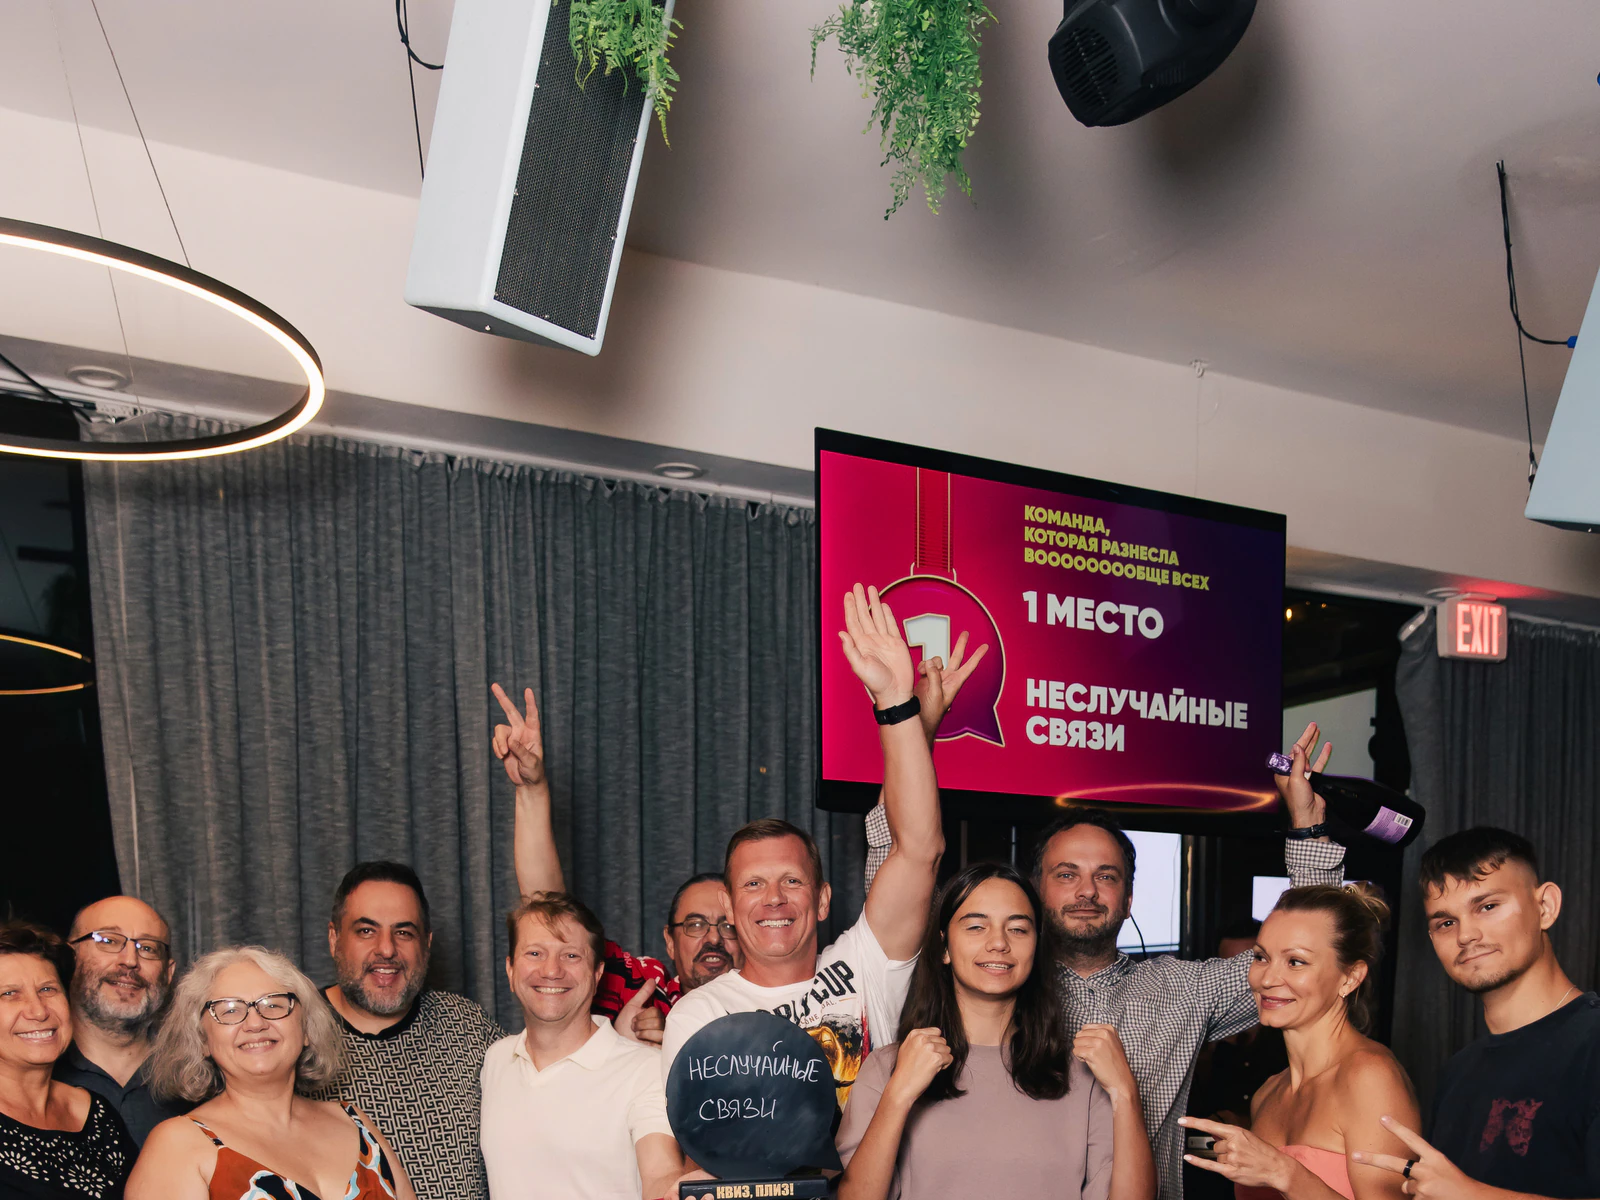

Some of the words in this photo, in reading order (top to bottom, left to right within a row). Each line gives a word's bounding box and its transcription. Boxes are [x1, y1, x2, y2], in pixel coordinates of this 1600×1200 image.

[1024, 505, 1111, 537] КОМАНДА,
[1024, 526, 1098, 553] КОТОРАЯ
[1101, 539, 1179, 566] РАЗНЕСЛА
[1024, 547, 1170, 585] ВООООООООБЩЕ
[1172, 571, 1210, 591] ВСЕХ
[1022, 590, 1038, 623] 1
[1047, 593, 1164, 639] МЕСТО
[1456, 603, 1502, 656] EXIT
[1026, 678, 1248, 729] НЕСЛУЧАЙНЫЕ
[1025, 715, 1125, 752] СВЯЗИ
[810, 960, 857, 1004] CUP
[688, 1040, 823, 1083] НЕСЛУЧАЙНЫЕ
[699, 1097, 776, 1120] СВЯЗИ
[716, 1185, 753, 1200] КВИЗ,
[755, 1182, 794, 1197] ПЛИЗ!
